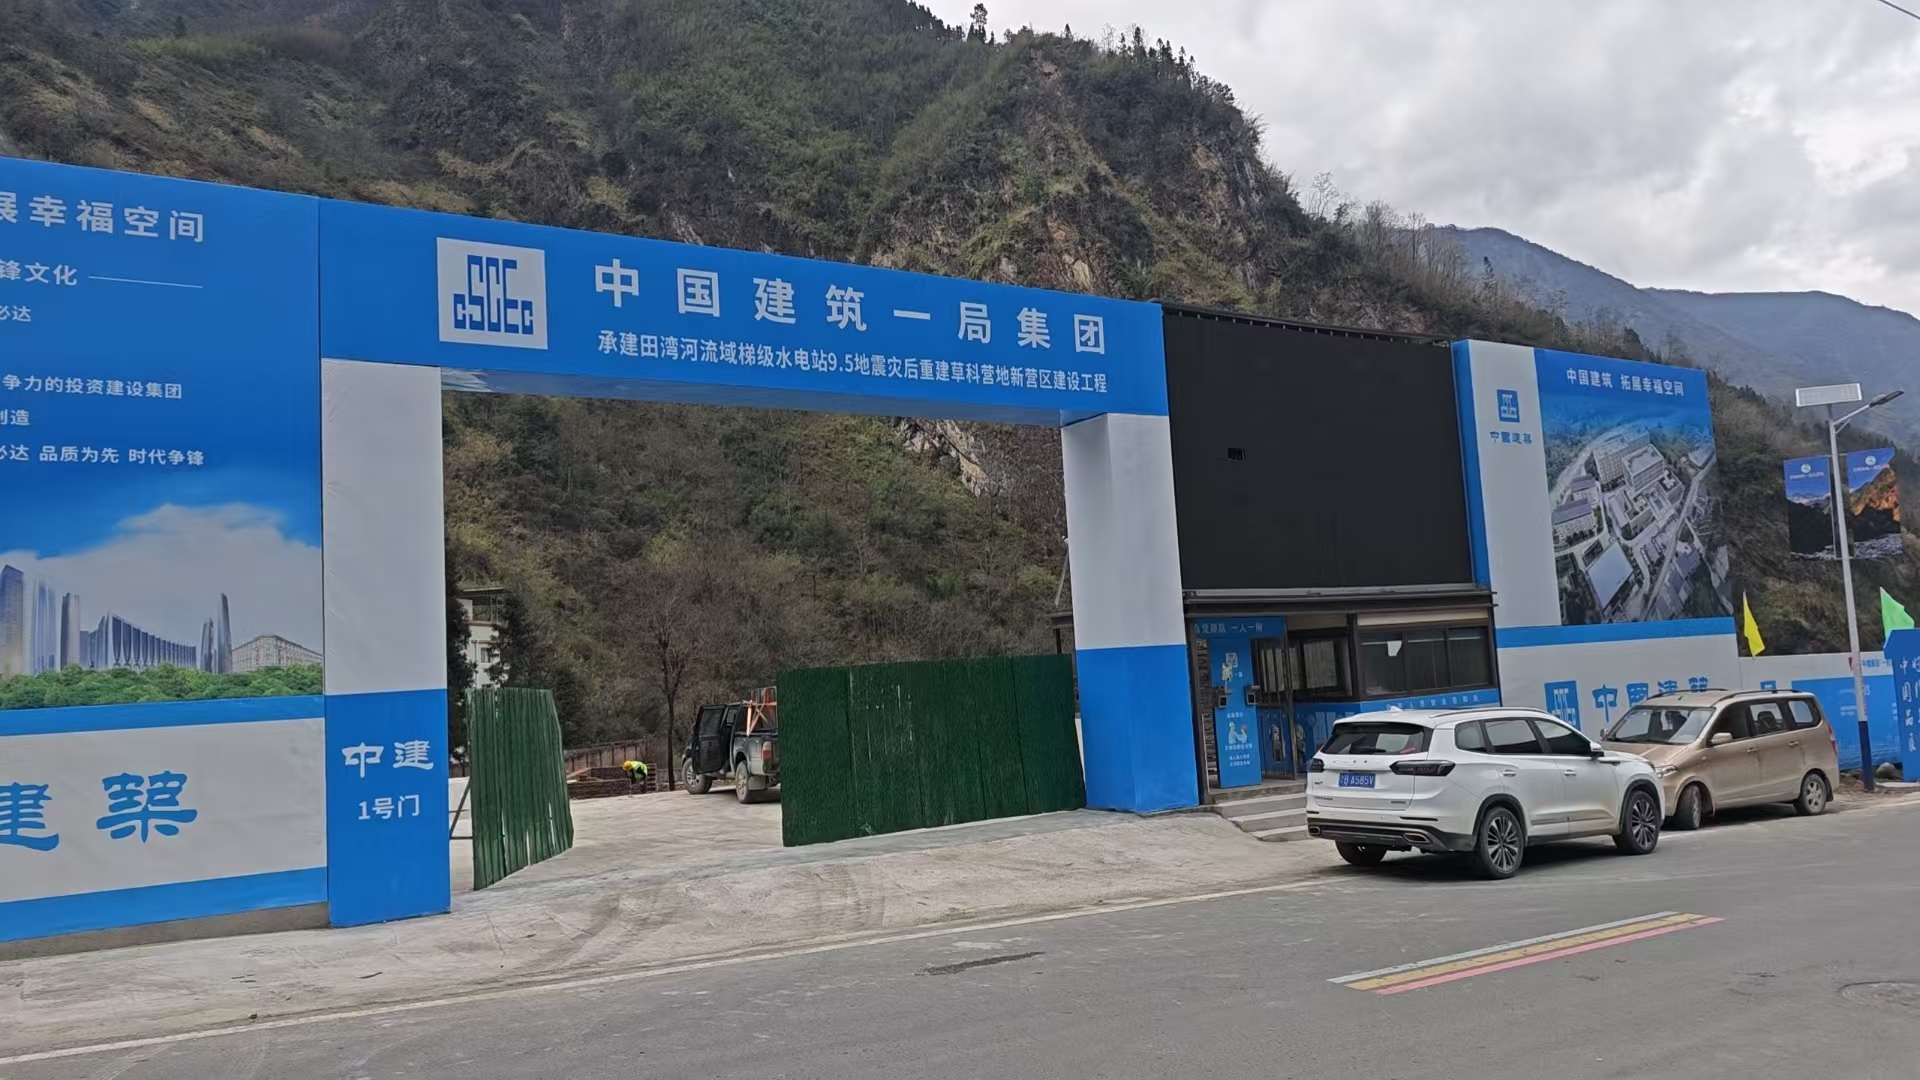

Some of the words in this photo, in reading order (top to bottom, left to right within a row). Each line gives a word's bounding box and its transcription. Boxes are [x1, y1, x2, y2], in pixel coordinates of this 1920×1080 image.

[595, 258, 1106, 355] 中国建筑一局集团
[1566, 368, 1613, 388] 中国建筑
[1620, 374, 1684, 396] 拓展幸福空间
[39, 445, 119, 464] 品质为先
[128, 448, 204, 466] 时代争锋
[357, 794, 420, 820] 1号门
